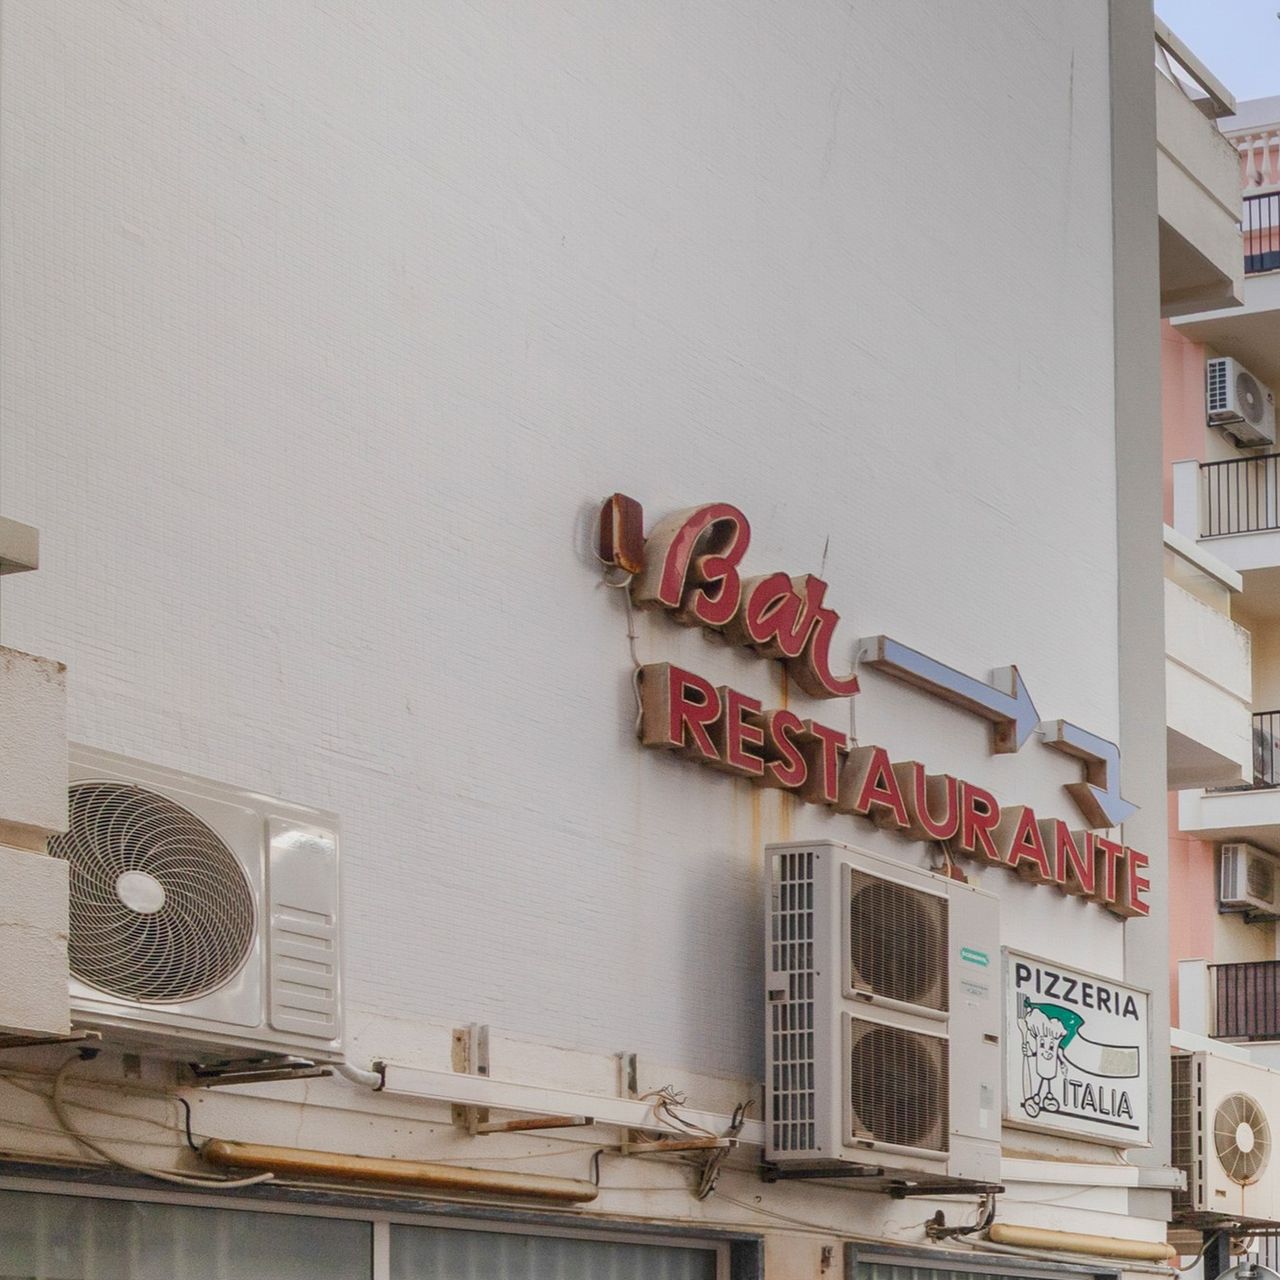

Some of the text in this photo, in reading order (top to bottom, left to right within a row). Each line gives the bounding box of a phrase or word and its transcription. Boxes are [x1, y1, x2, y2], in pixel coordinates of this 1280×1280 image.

[655, 500, 863, 698] Bar
[667, 664, 1151, 918] RESTAURANTE
[1016, 963, 1139, 1021] PIZZERIA
[1063, 1078, 1133, 1119] ITALIA
